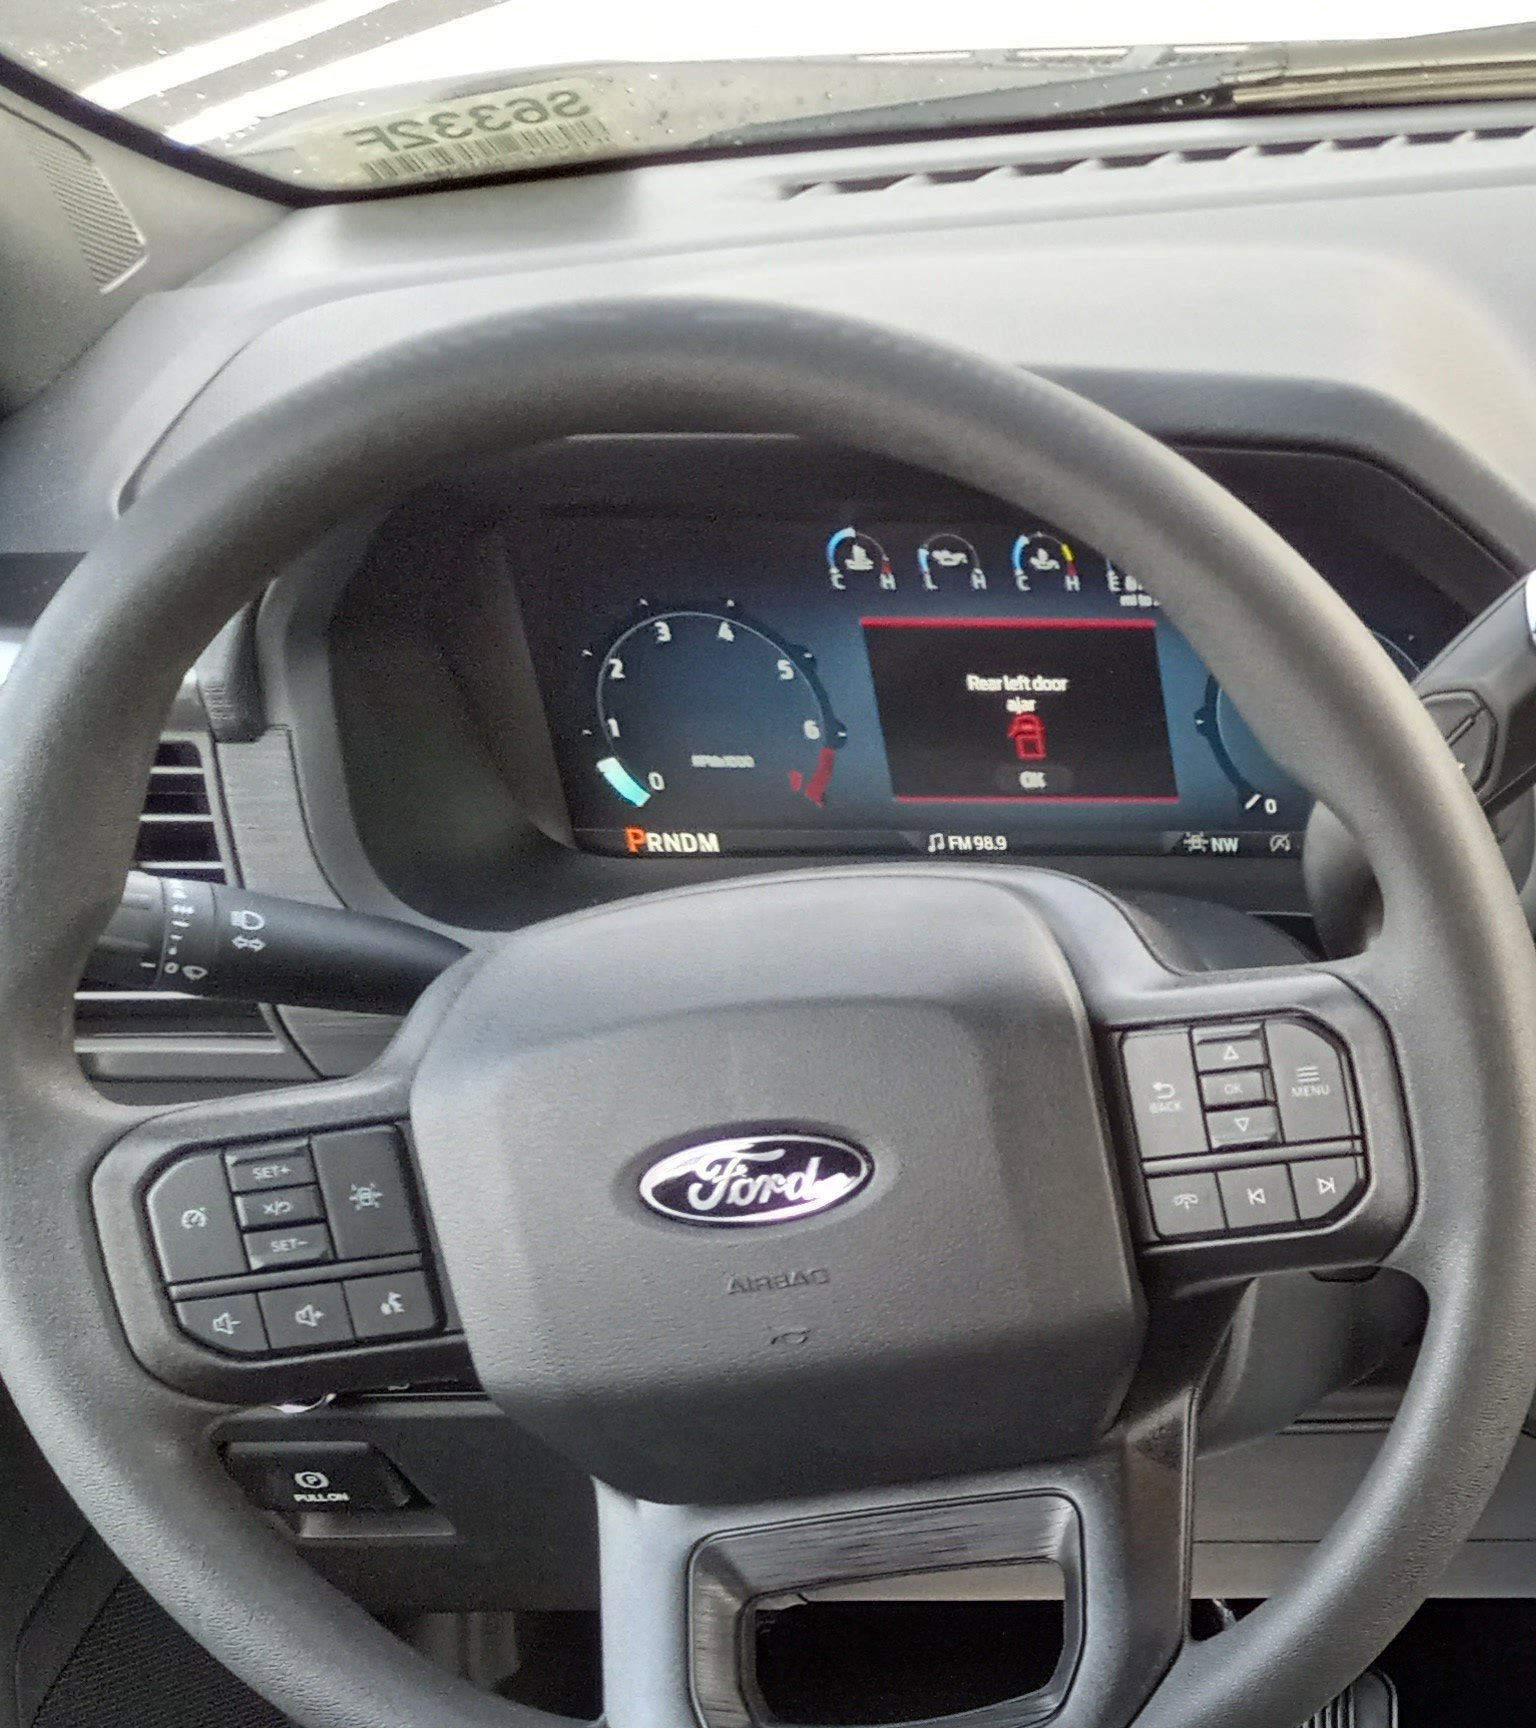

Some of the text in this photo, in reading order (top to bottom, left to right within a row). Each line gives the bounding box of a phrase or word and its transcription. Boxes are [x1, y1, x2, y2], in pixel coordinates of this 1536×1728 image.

[653, 621, 672, 643] 3
[716, 621, 735, 643] 4
[608, 659, 626, 680] 2
[776, 659, 795, 680] 5
[965, 672, 1070, 692] Rear left door
[607, 718, 621, 738] 1
[803, 720, 821, 740] 6
[648, 771, 666, 791] 0
[1264, 798, 1278, 814] 0
[947, 836, 1008, 852] FM 98.9
[1210, 837, 1239, 853] NW
[1222, 1083, 1244, 1095] OK
[1290, 1084, 1330, 1098] MENU
